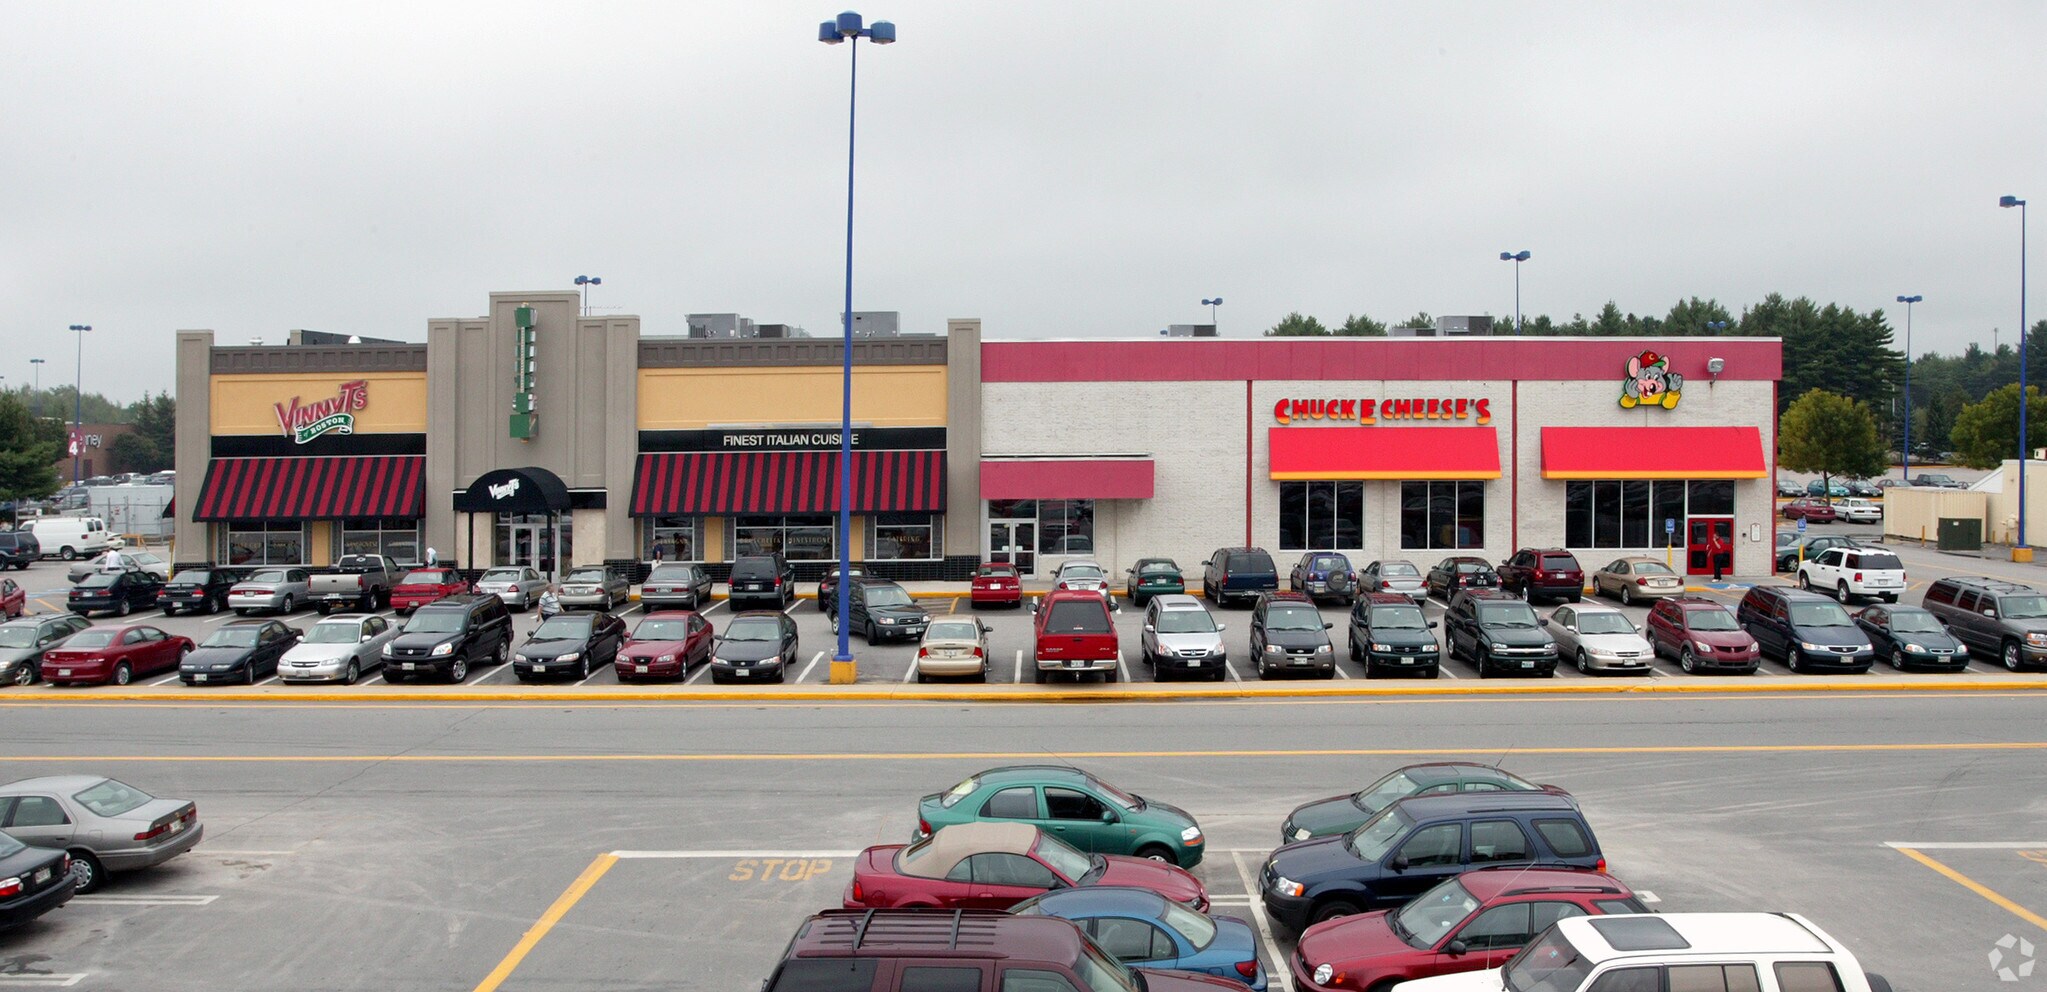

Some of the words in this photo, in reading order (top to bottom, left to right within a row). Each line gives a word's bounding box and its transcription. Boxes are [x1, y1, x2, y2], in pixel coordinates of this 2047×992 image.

[1274, 398, 1356, 425] CHUCK
[1360, 398, 1376, 425] E
[1380, 398, 1491, 425] CHEESE'S
[310, 416, 345, 434] BOSTON
[69, 441, 78, 455] 4
[723, 435, 764, 446] FINEST
[767, 434, 809, 446] ITALIAN
[811, 433, 859, 445] CUISIE
[728, 858, 833, 881] STOP
